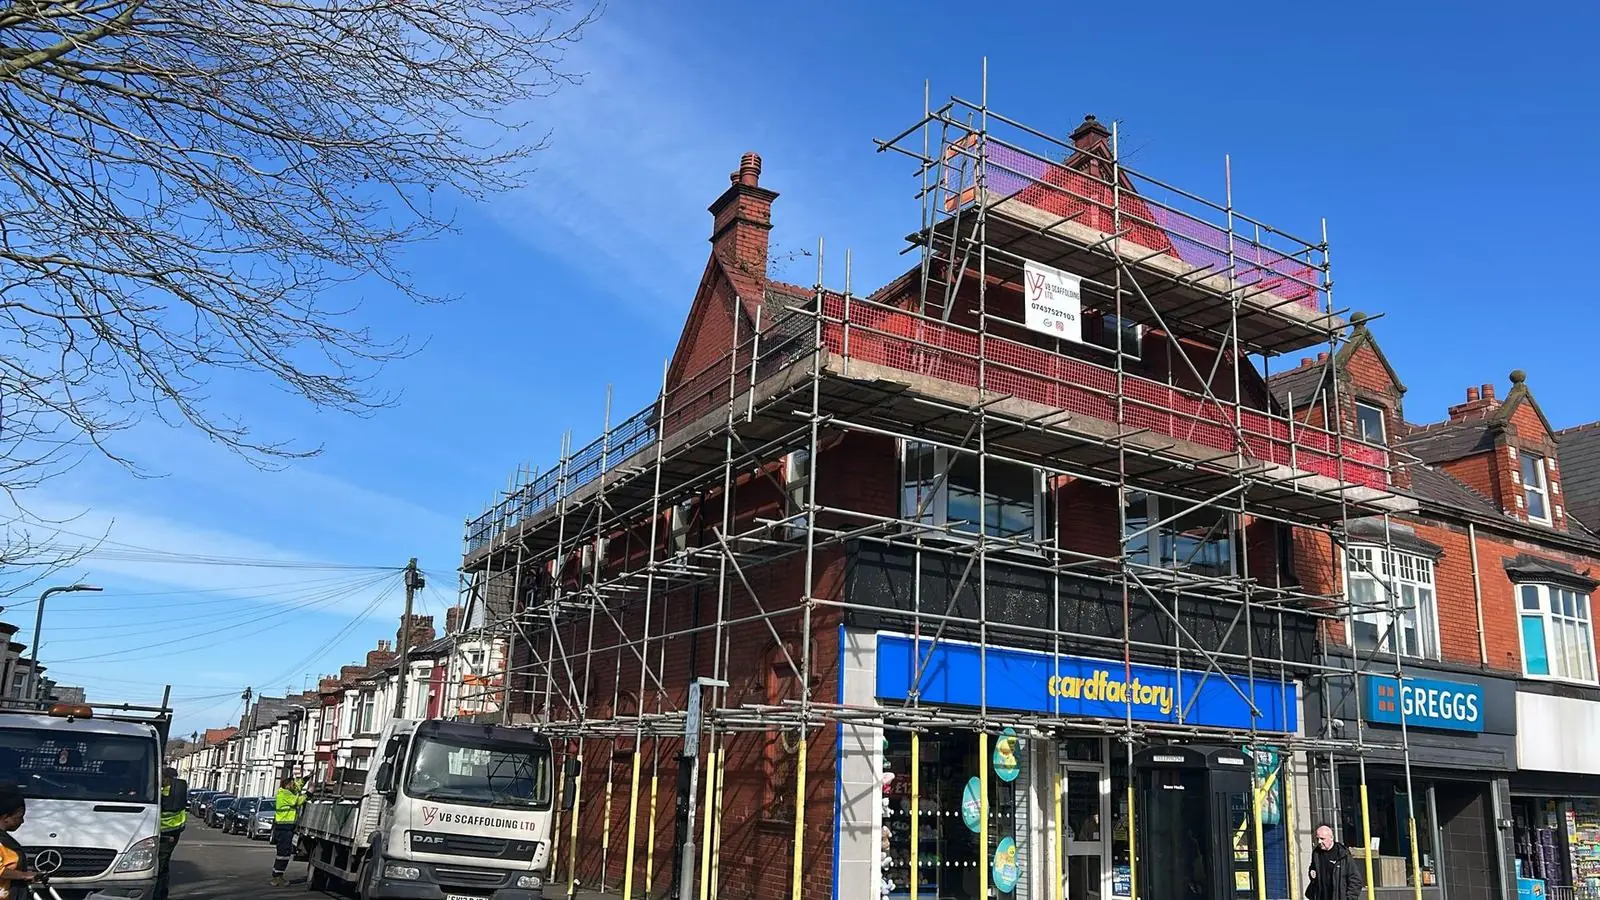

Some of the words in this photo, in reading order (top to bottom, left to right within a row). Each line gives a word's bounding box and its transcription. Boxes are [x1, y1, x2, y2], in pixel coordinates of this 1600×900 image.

[1051, 284, 1080, 300] SCAFFOLDING
[1031, 302, 1075, 321] 07437527103
[1048, 669, 1174, 714] cardfactory
[1401, 686, 1478, 722] GREGGS
[439, 812, 452, 822] VB
[455, 814, 518, 829] SCAFFOLDING
[520, 820, 536, 831] LTD
[412, 835, 445, 844] DAF
